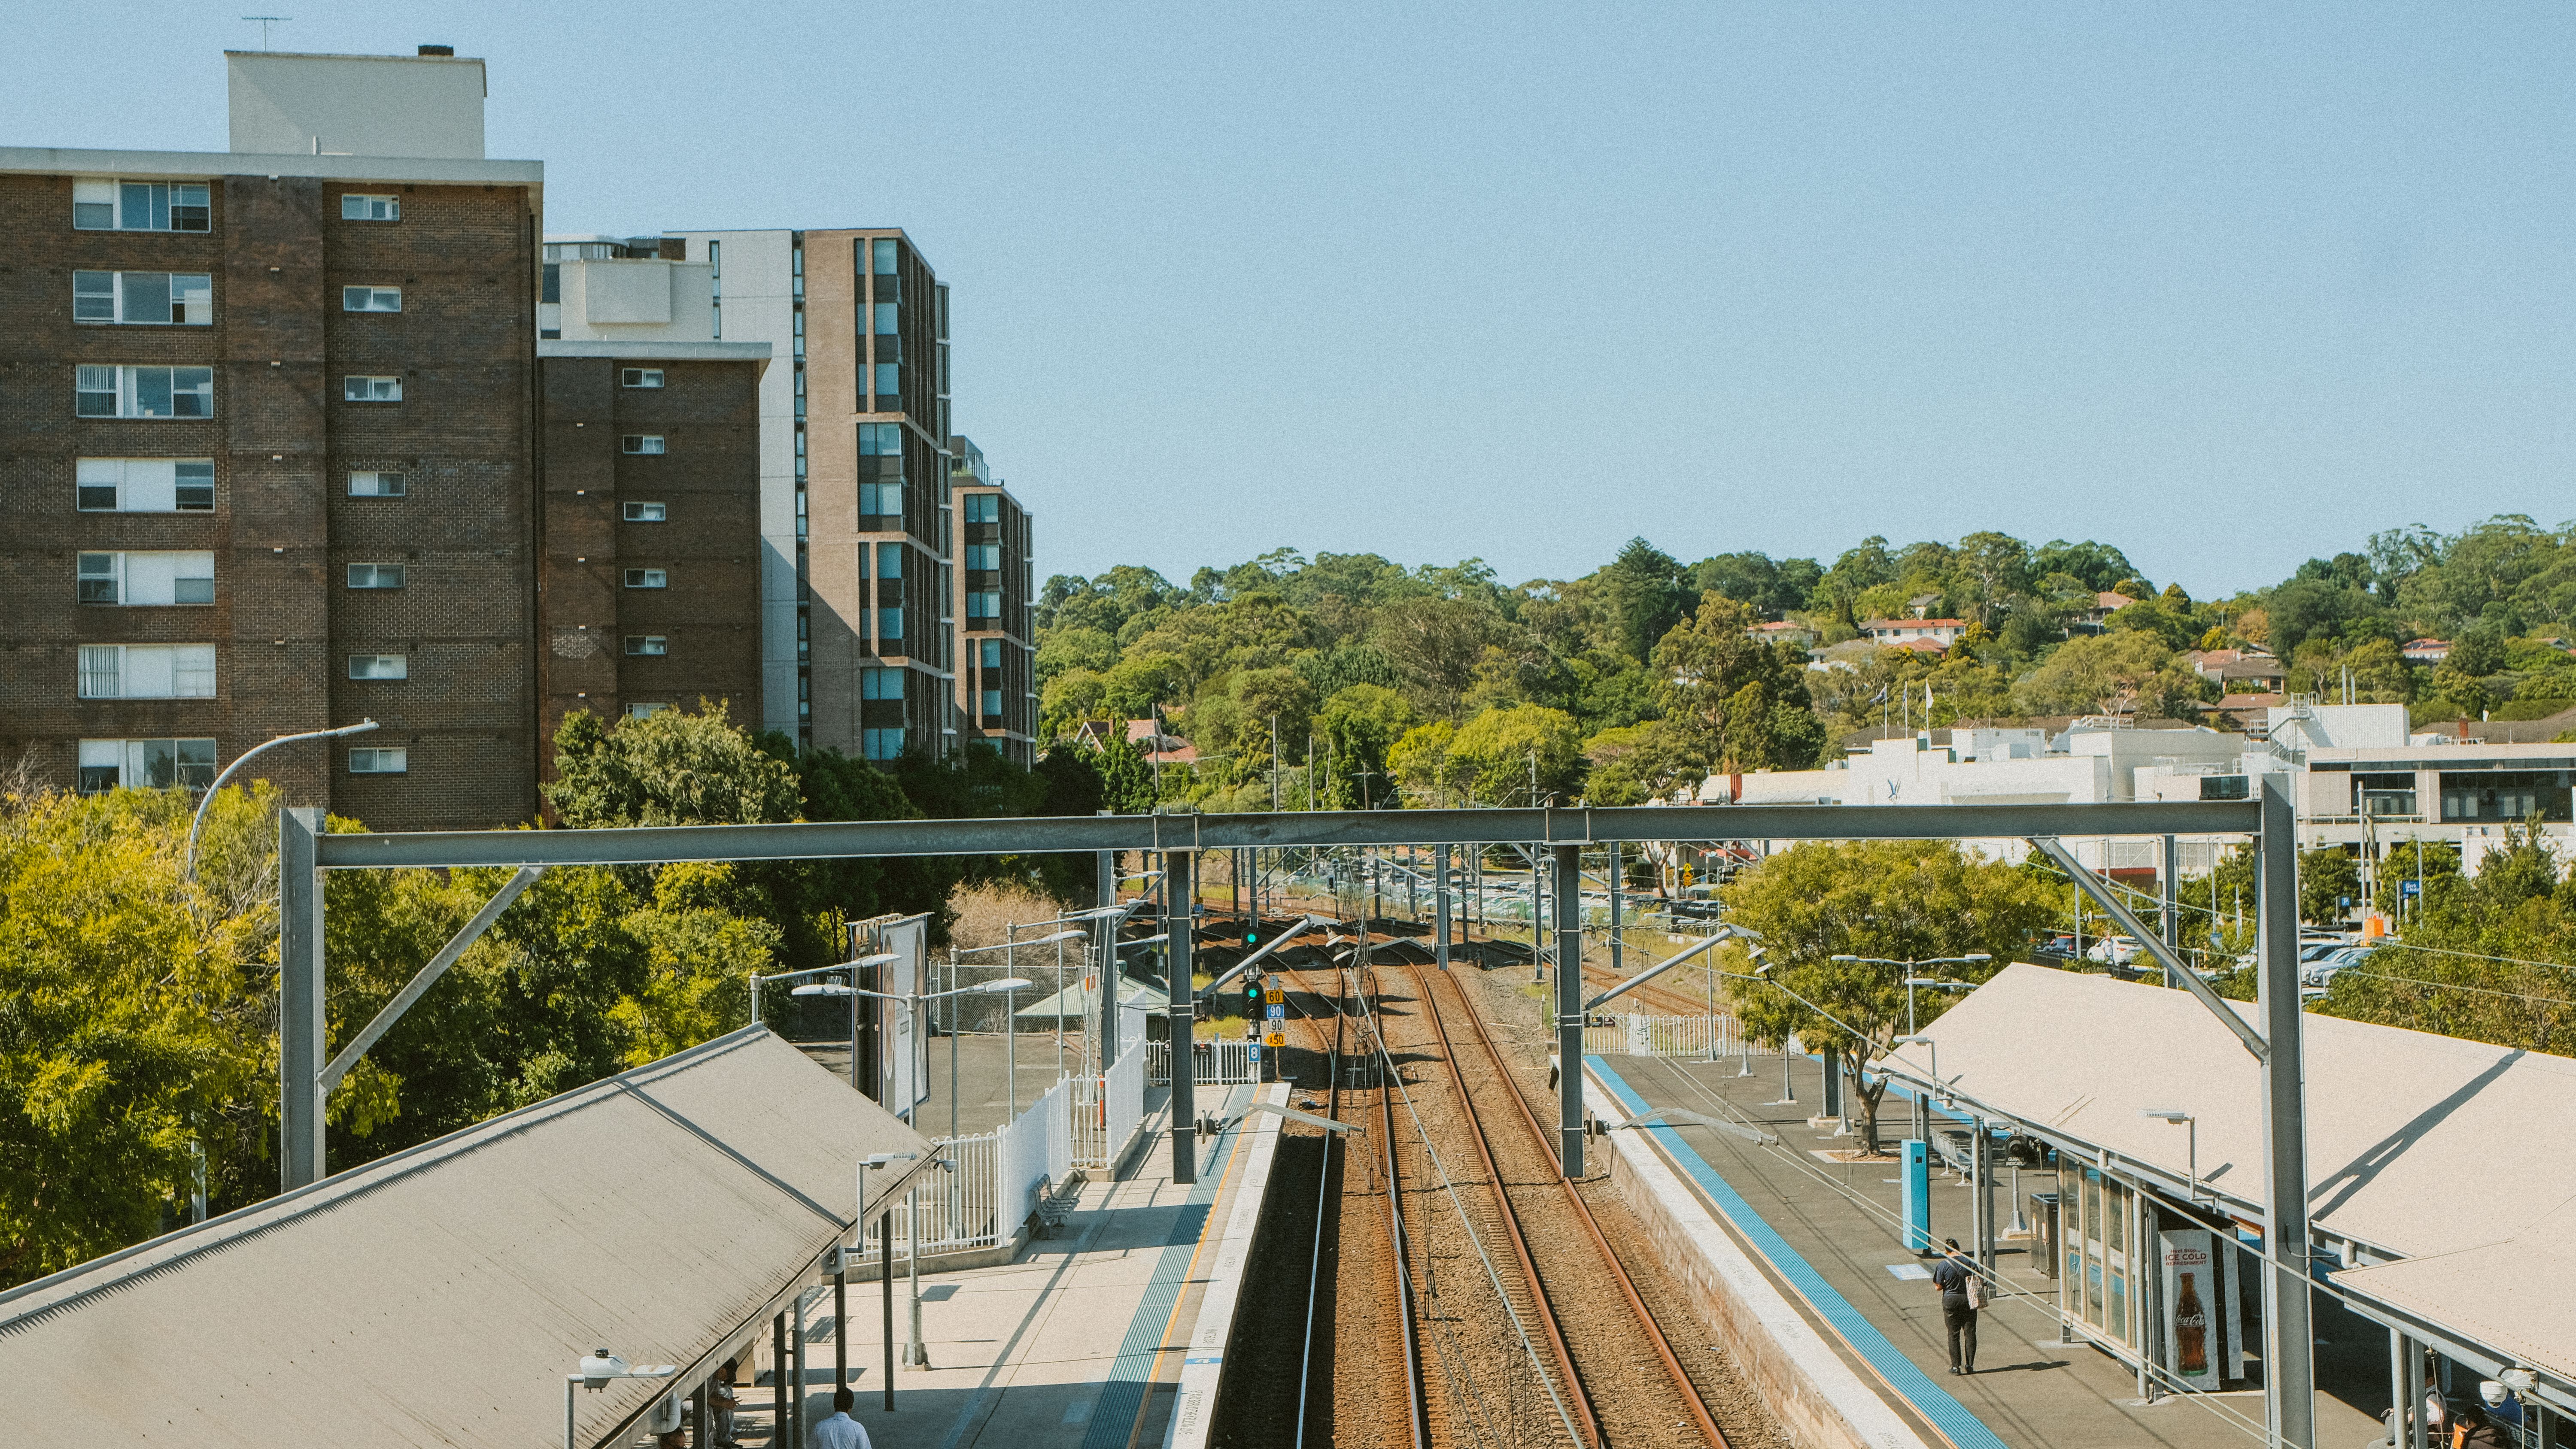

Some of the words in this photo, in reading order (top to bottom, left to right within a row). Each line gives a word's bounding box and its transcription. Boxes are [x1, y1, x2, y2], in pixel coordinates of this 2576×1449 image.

[1269, 991, 1280, 1002] 60
[1270, 1006, 1281, 1017] 90
[1272, 1020, 1282, 1031] 90
[1250, 1047, 1258, 1059] 8
